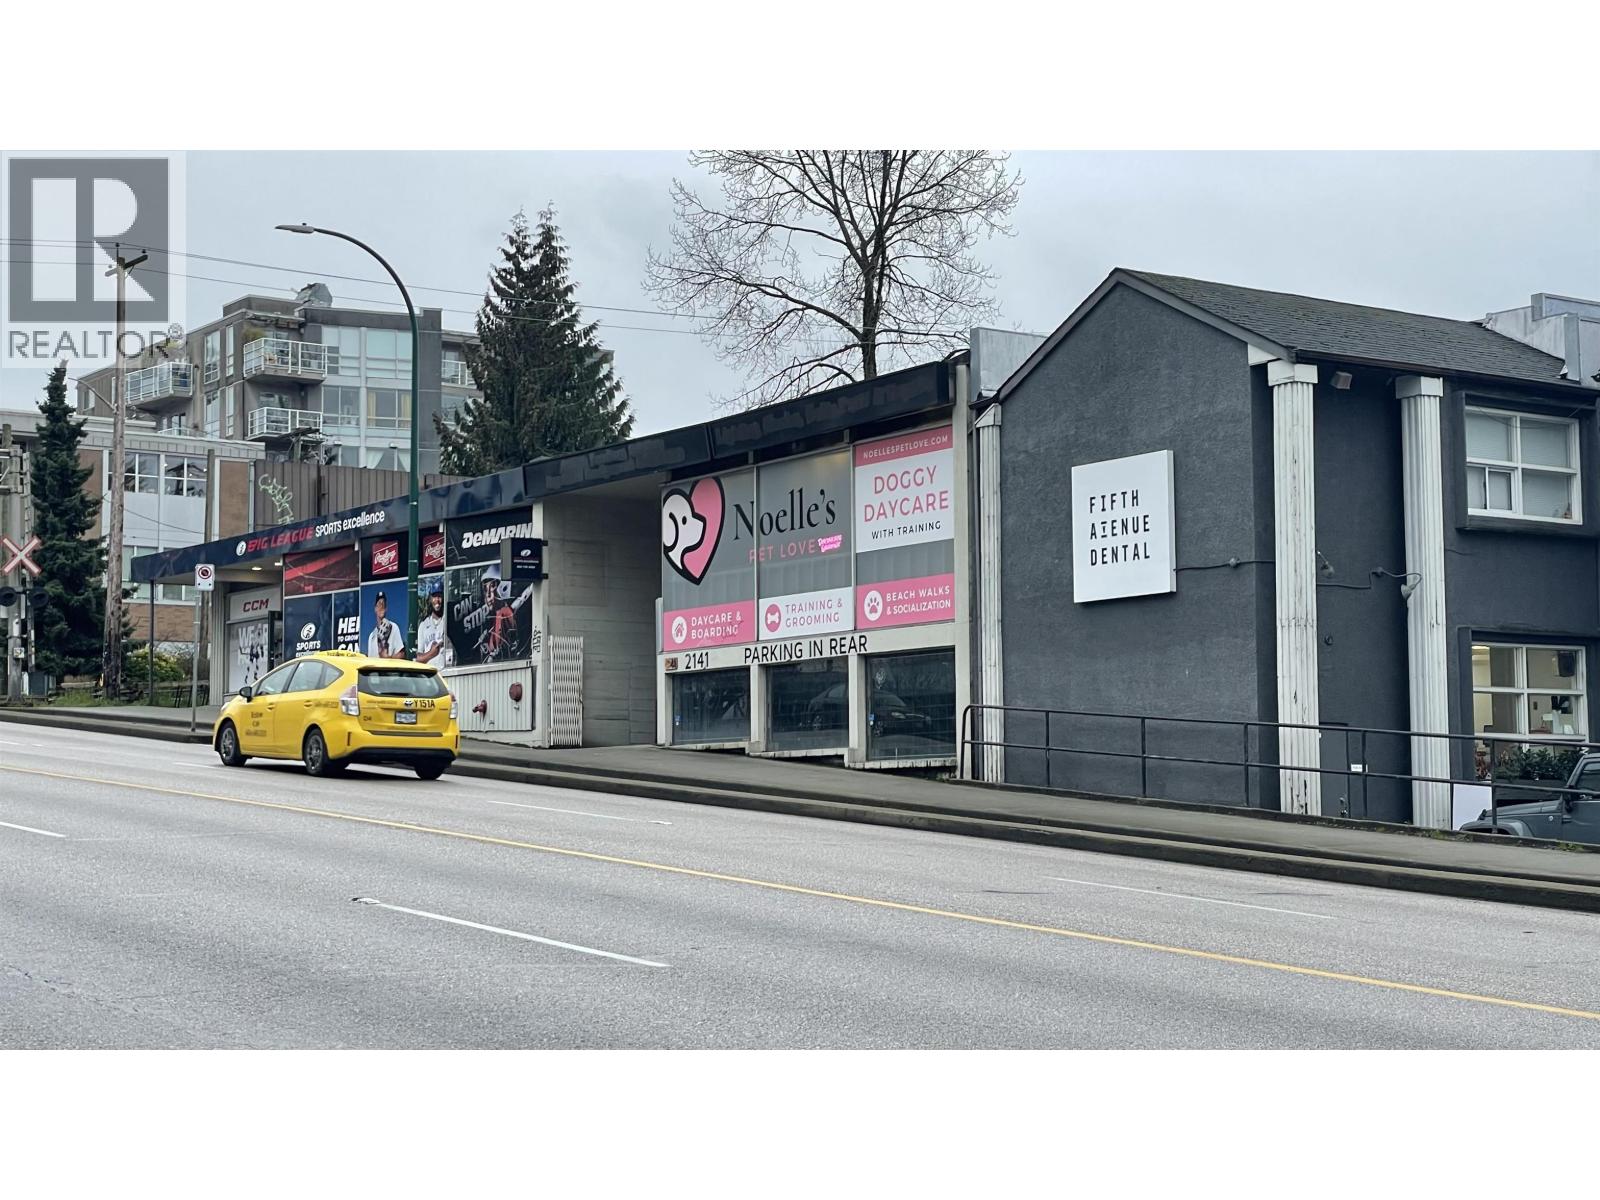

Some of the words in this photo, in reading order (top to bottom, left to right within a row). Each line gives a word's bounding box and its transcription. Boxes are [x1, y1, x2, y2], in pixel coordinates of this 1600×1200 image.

[863, 434, 949, 459] NOELLESPETLOVE.COM
[873, 465, 937, 495] DOGGY
[863, 490, 949, 523] DAYCARE
[1089, 489, 1139, 513] FIFTH
[733, 486, 837, 541] Noelle's
[270, 526, 314, 549] LEAGUE
[315, 520, 342, 538] SPORTS
[342, 510, 385, 530] excellence
[871, 528, 894, 540] WITH
[897, 520, 942, 536] TRAINING
[748, 545, 774, 564] PET
[780, 538, 816, 558] LOVE
[1090, 542, 1151, 566] DENTAL
[886, 592, 916, 603] BEACH
[919, 585, 951, 598] WALKS
[243, 598, 269, 612] CCM
[785, 599, 833, 615] TRAINING
[837, 597, 844, 608] &
[886, 607, 892, 616] &
[892, 599, 951, 615] SOCIALIZATION
[691, 611, 732, 627] DAYCARE
[735, 611, 741, 621] &
[785, 612, 840, 629] GROOMING
[691, 624, 739, 640] BOARDING
[296, 640, 321, 651] SPORTS
[744, 642, 803, 665] PARKING
[809, 638, 823, 658] IN
[829, 635, 868, 656] REAR
[684, 651, 710, 670] 2141
